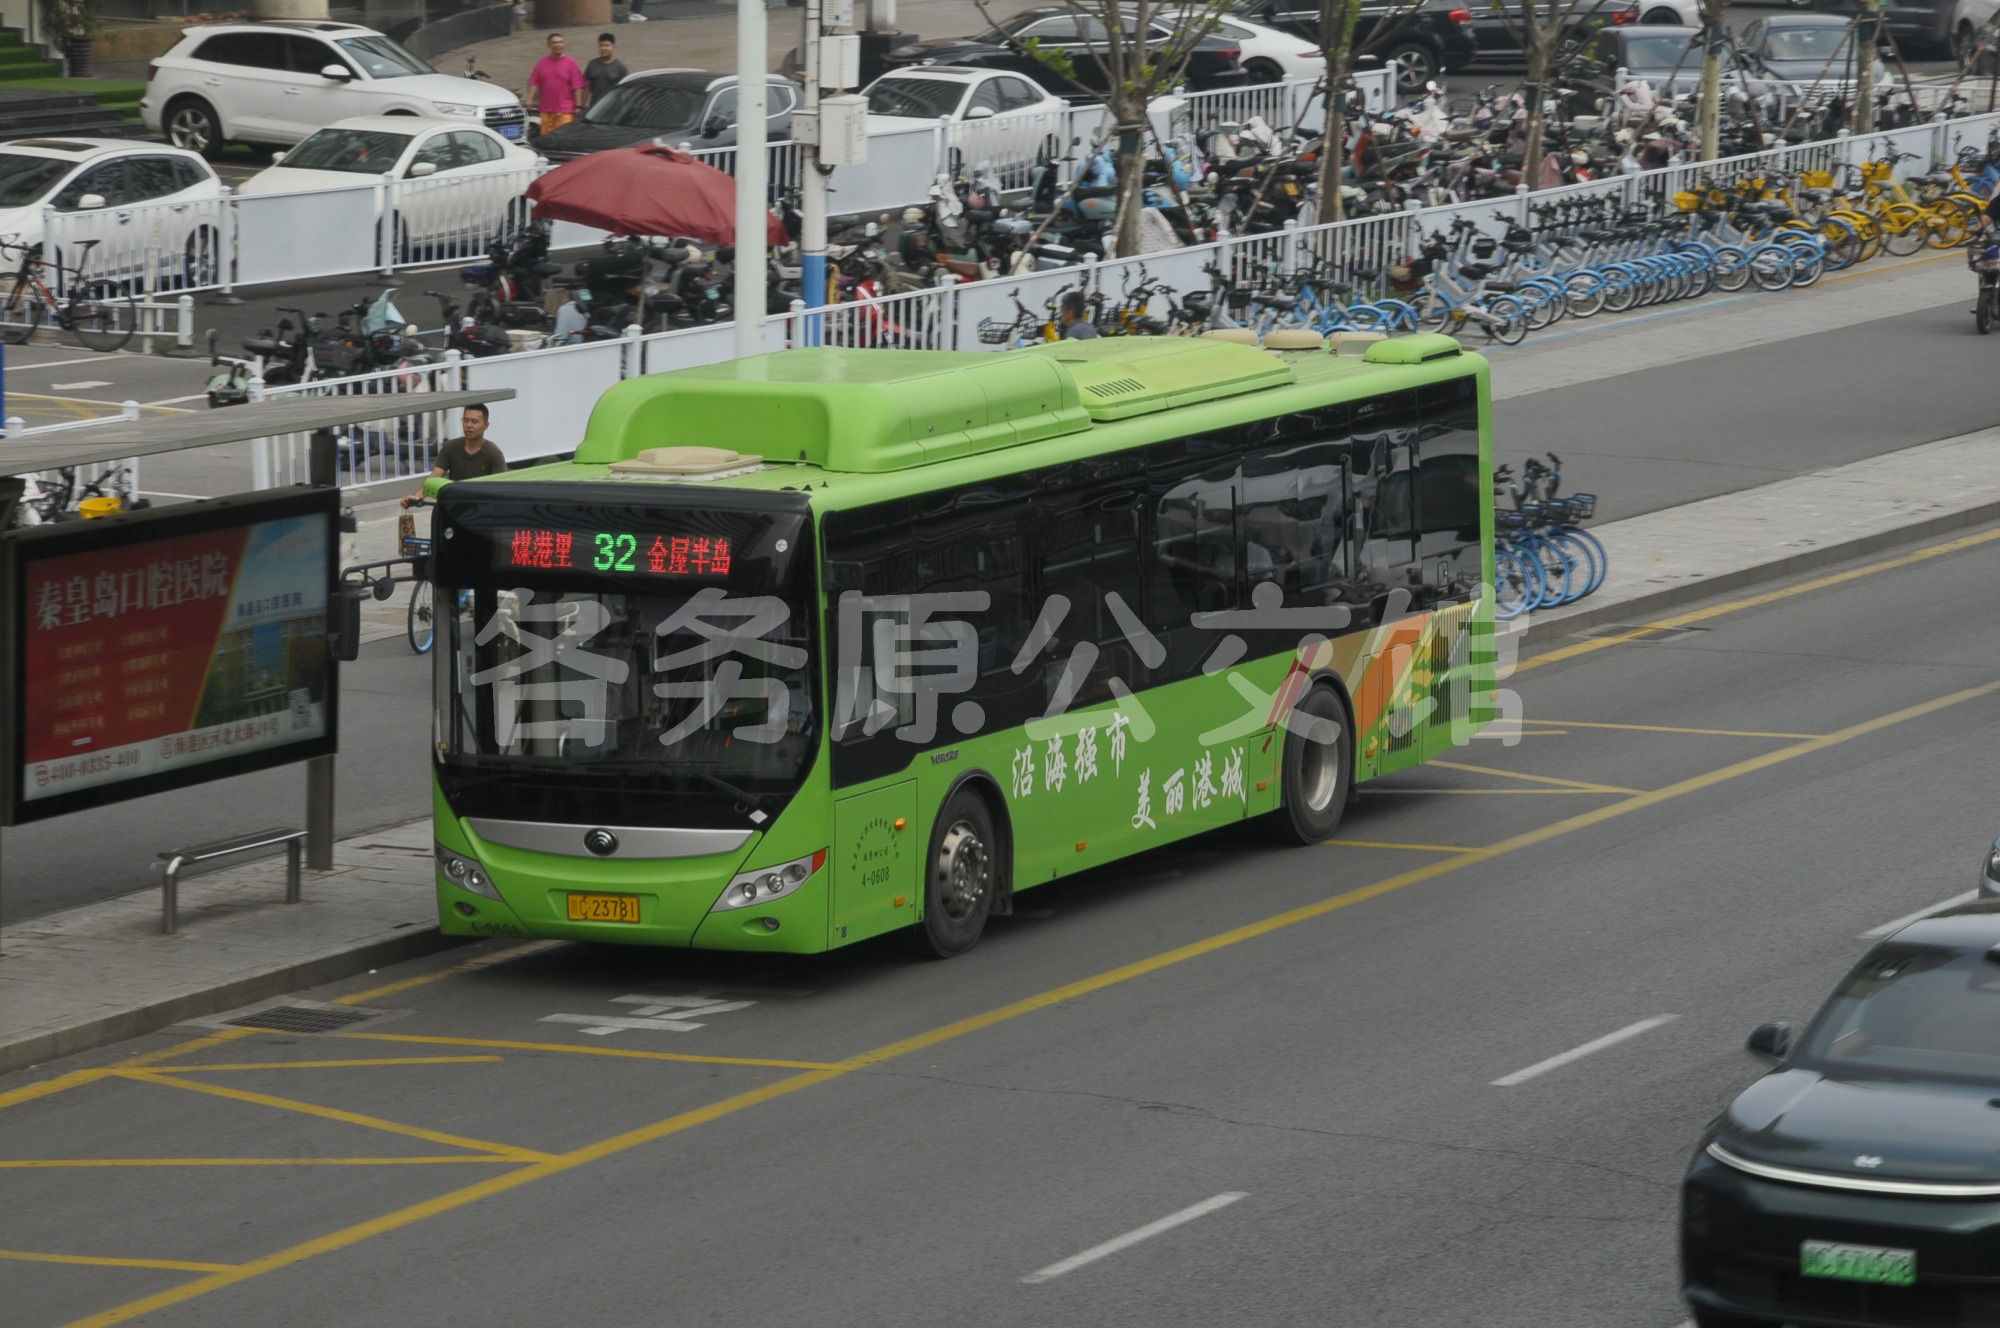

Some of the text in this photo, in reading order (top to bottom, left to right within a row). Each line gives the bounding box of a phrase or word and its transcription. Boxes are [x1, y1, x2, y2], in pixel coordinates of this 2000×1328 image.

[36, 552, 229, 631] 秦皇岛口腔医院
[594, 533, 637, 571] 32
[1012, 712, 1130, 799] 沿海强市
[1131, 747, 1246, 830] 美丽港城
[861, 866, 890, 887] 4-0608
